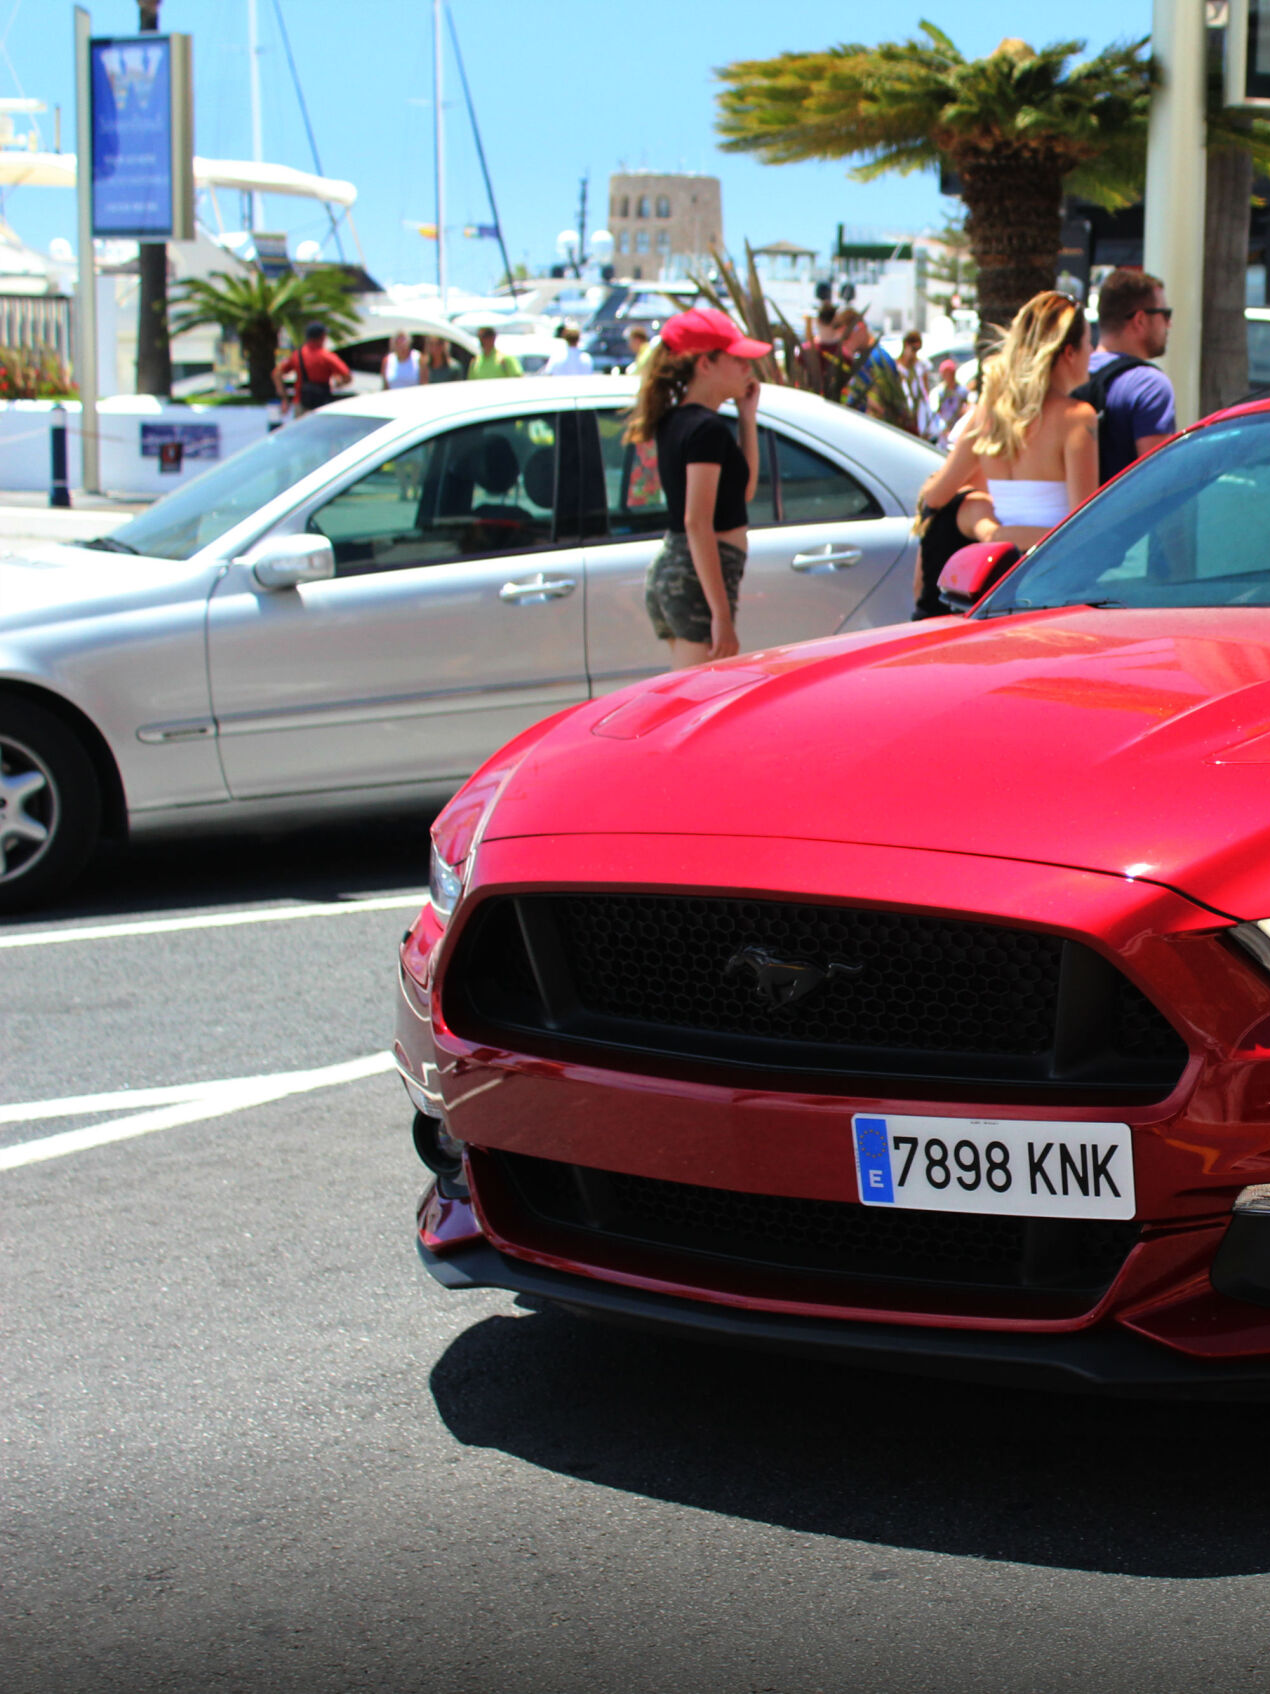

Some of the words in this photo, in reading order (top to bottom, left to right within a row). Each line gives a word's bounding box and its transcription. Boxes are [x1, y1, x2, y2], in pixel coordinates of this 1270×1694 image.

[868, 1169, 885, 1188] E
[893, 1136, 1013, 1193] 7898
[1027, 1141, 1122, 1198] KNK
